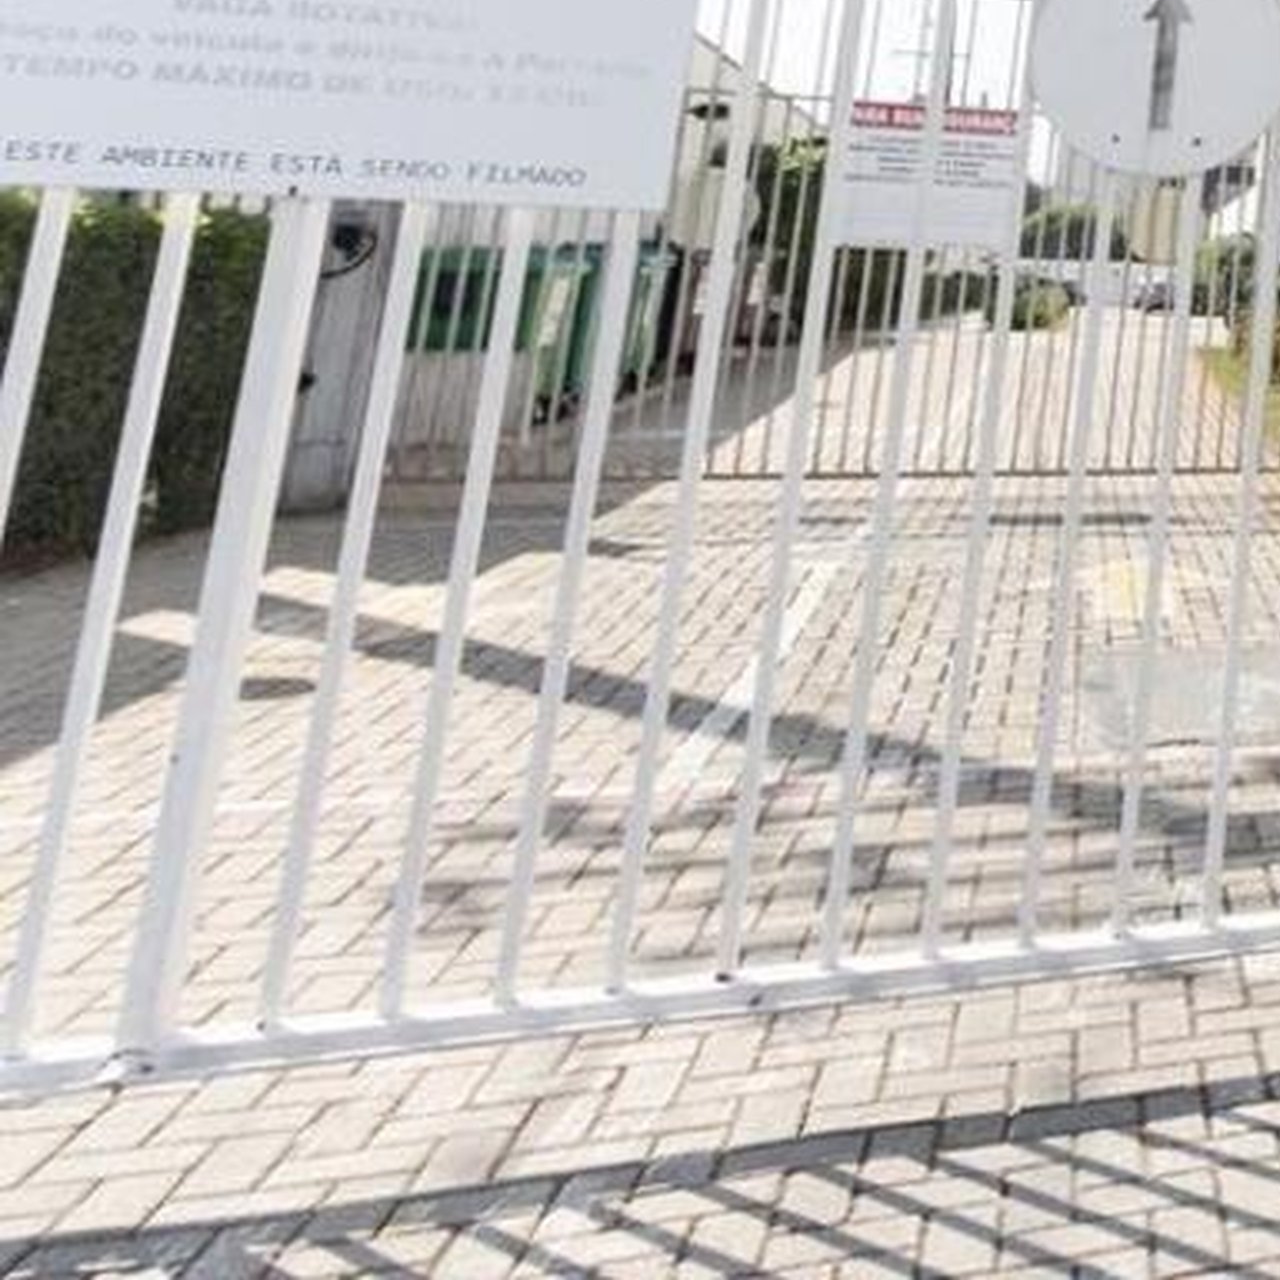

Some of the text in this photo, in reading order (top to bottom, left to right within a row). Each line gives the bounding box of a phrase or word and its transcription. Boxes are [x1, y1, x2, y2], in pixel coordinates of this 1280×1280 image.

[5, 139, 81, 165] ESTE
[101, 144, 250, 170] AMBIENTE
[360, 158, 449, 181] SENDO
[466, 162, 588, 188] FILMADO
